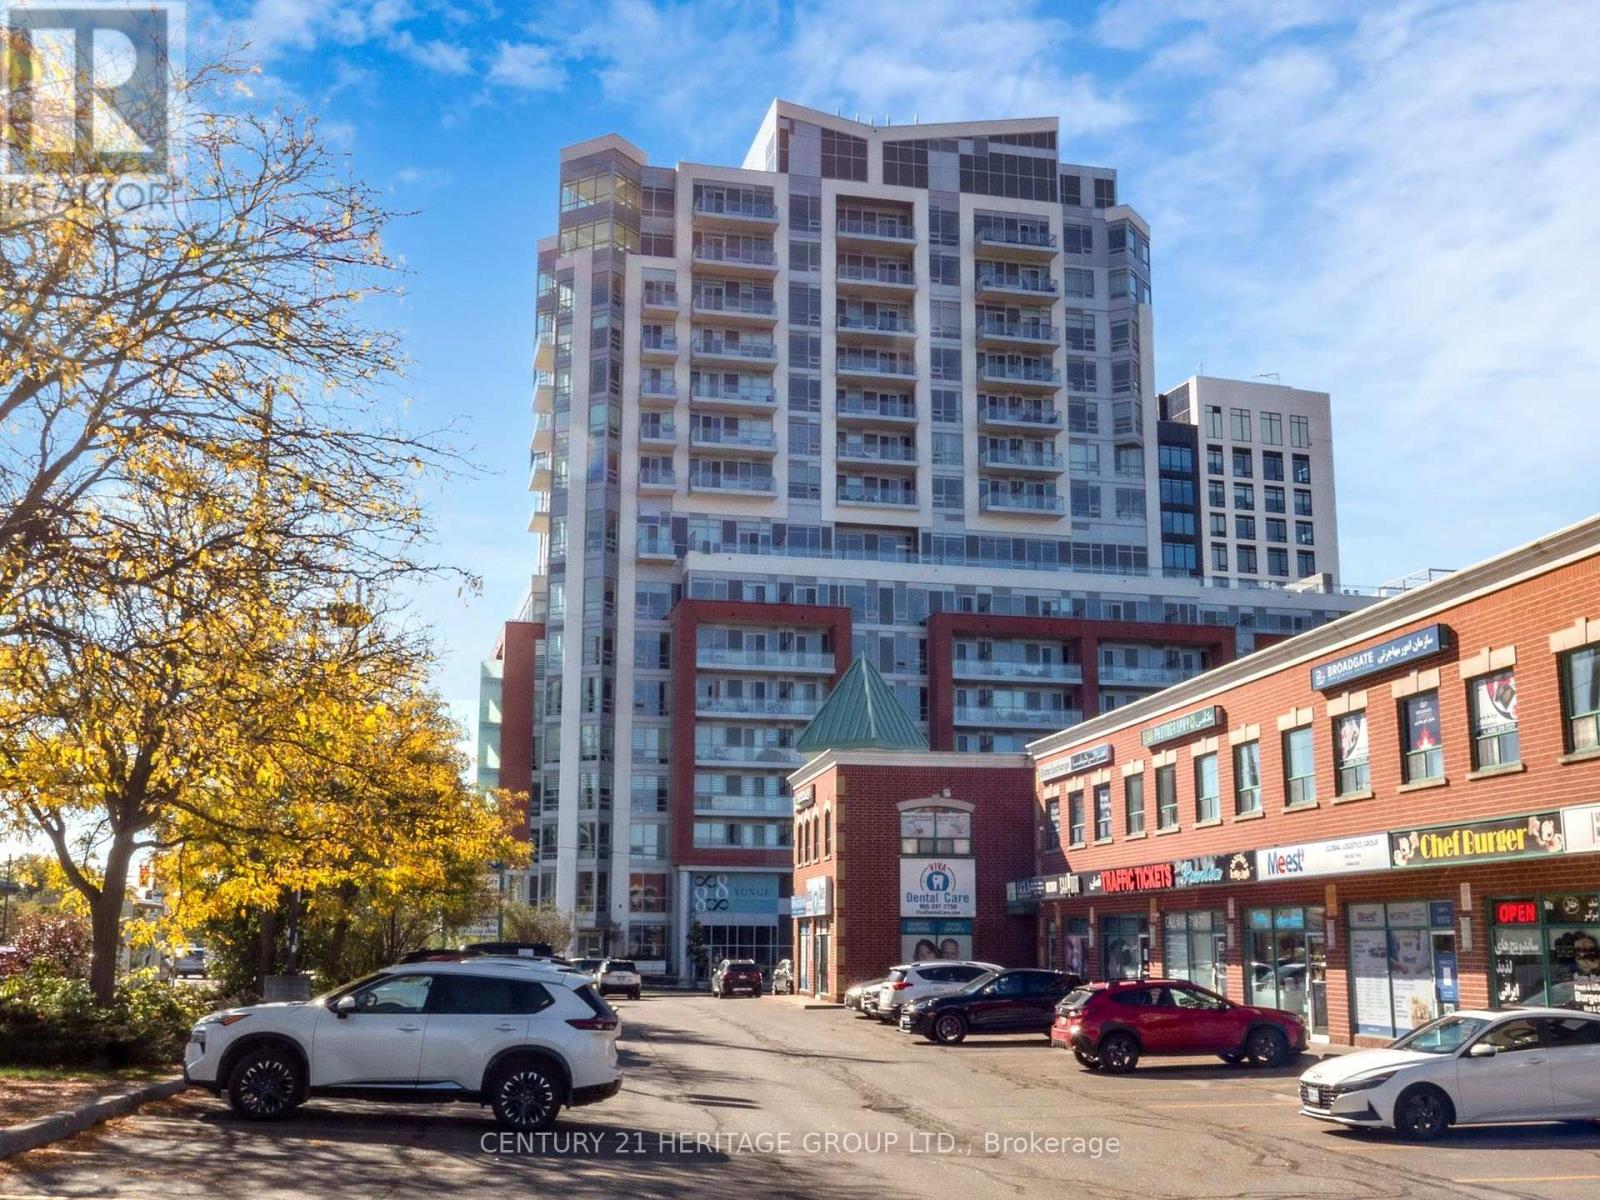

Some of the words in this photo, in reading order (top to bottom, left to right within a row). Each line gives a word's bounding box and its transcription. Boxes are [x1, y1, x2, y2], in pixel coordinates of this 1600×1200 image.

[1327, 651, 1374, 677] BROADGATE
[1420, 830, 1460, 859] Chef
[1462, 828, 1527, 855] Burger
[928, 862, 947, 872] VIVA
[1268, 849, 1304, 875] Meest
[1101, 868, 1135, 893] TRAFFIC
[1136, 863, 1172, 889] TICKETS
[906, 892, 939, 903] Dental
[943, 892, 970, 903] Care
[1498, 903, 1536, 922] OPEN
[1574, 991, 1600, 1005] Burge
